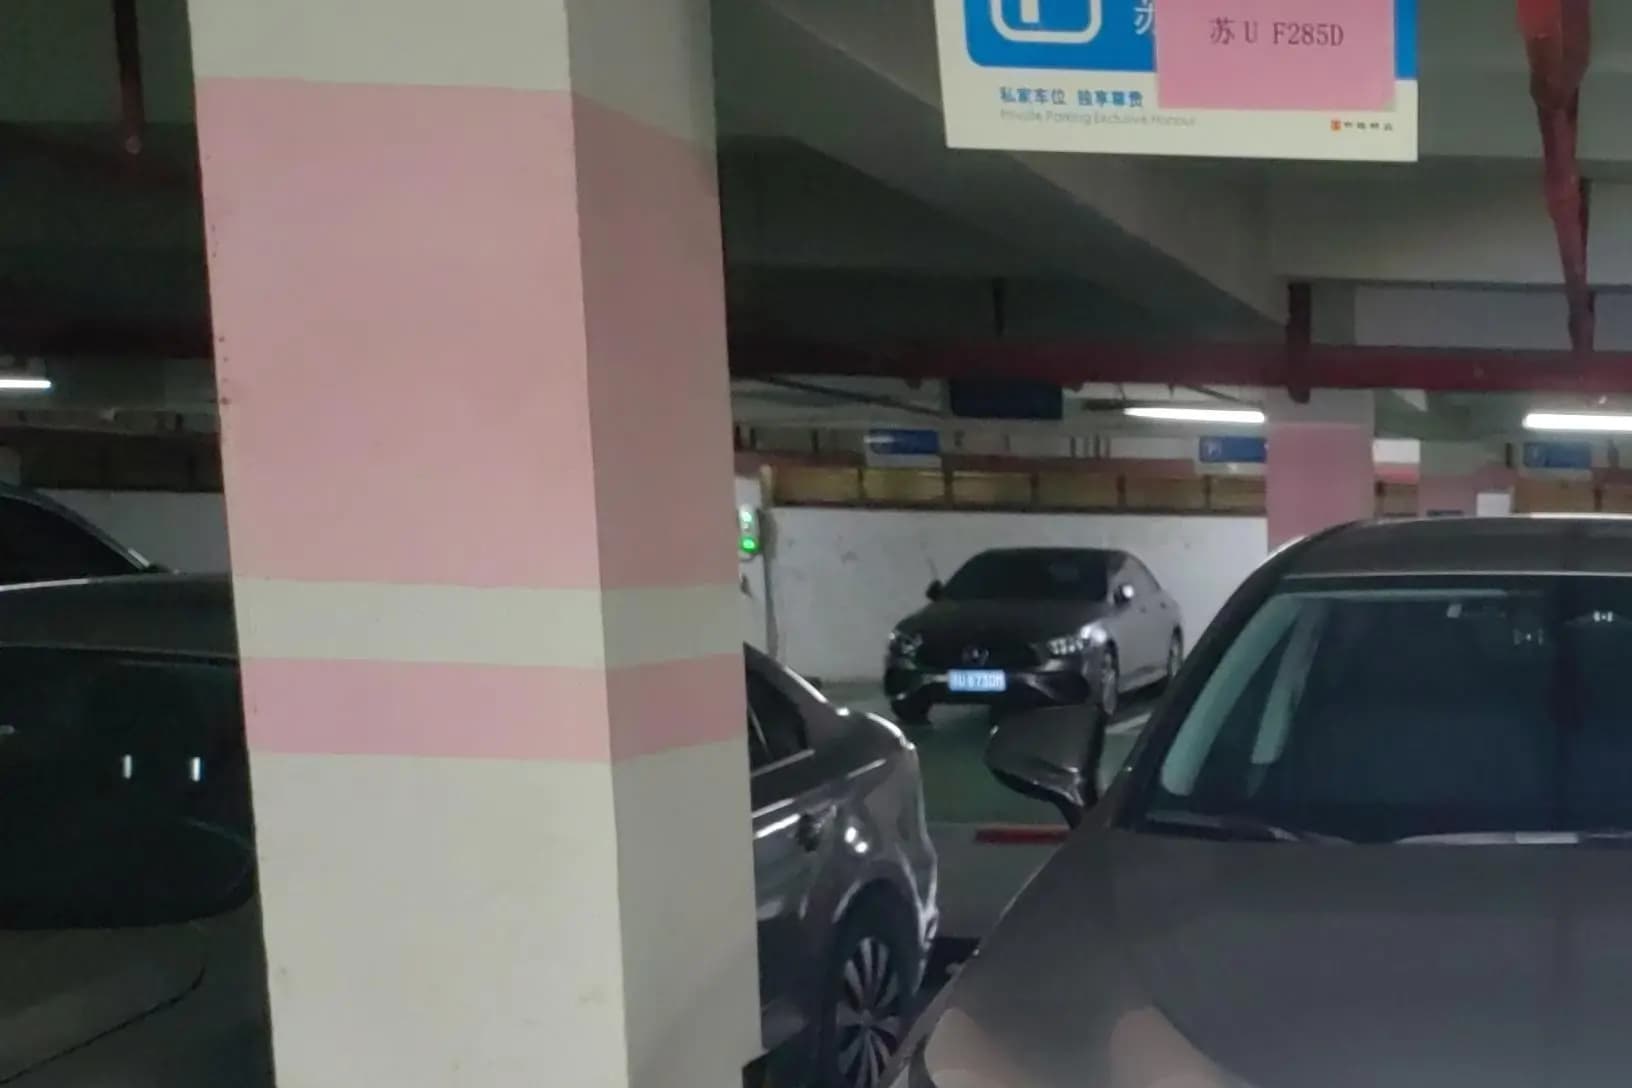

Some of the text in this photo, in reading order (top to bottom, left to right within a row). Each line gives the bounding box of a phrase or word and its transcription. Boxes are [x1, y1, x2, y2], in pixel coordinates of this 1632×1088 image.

[1208, 16, 1345, 46] 苏 U F285D
